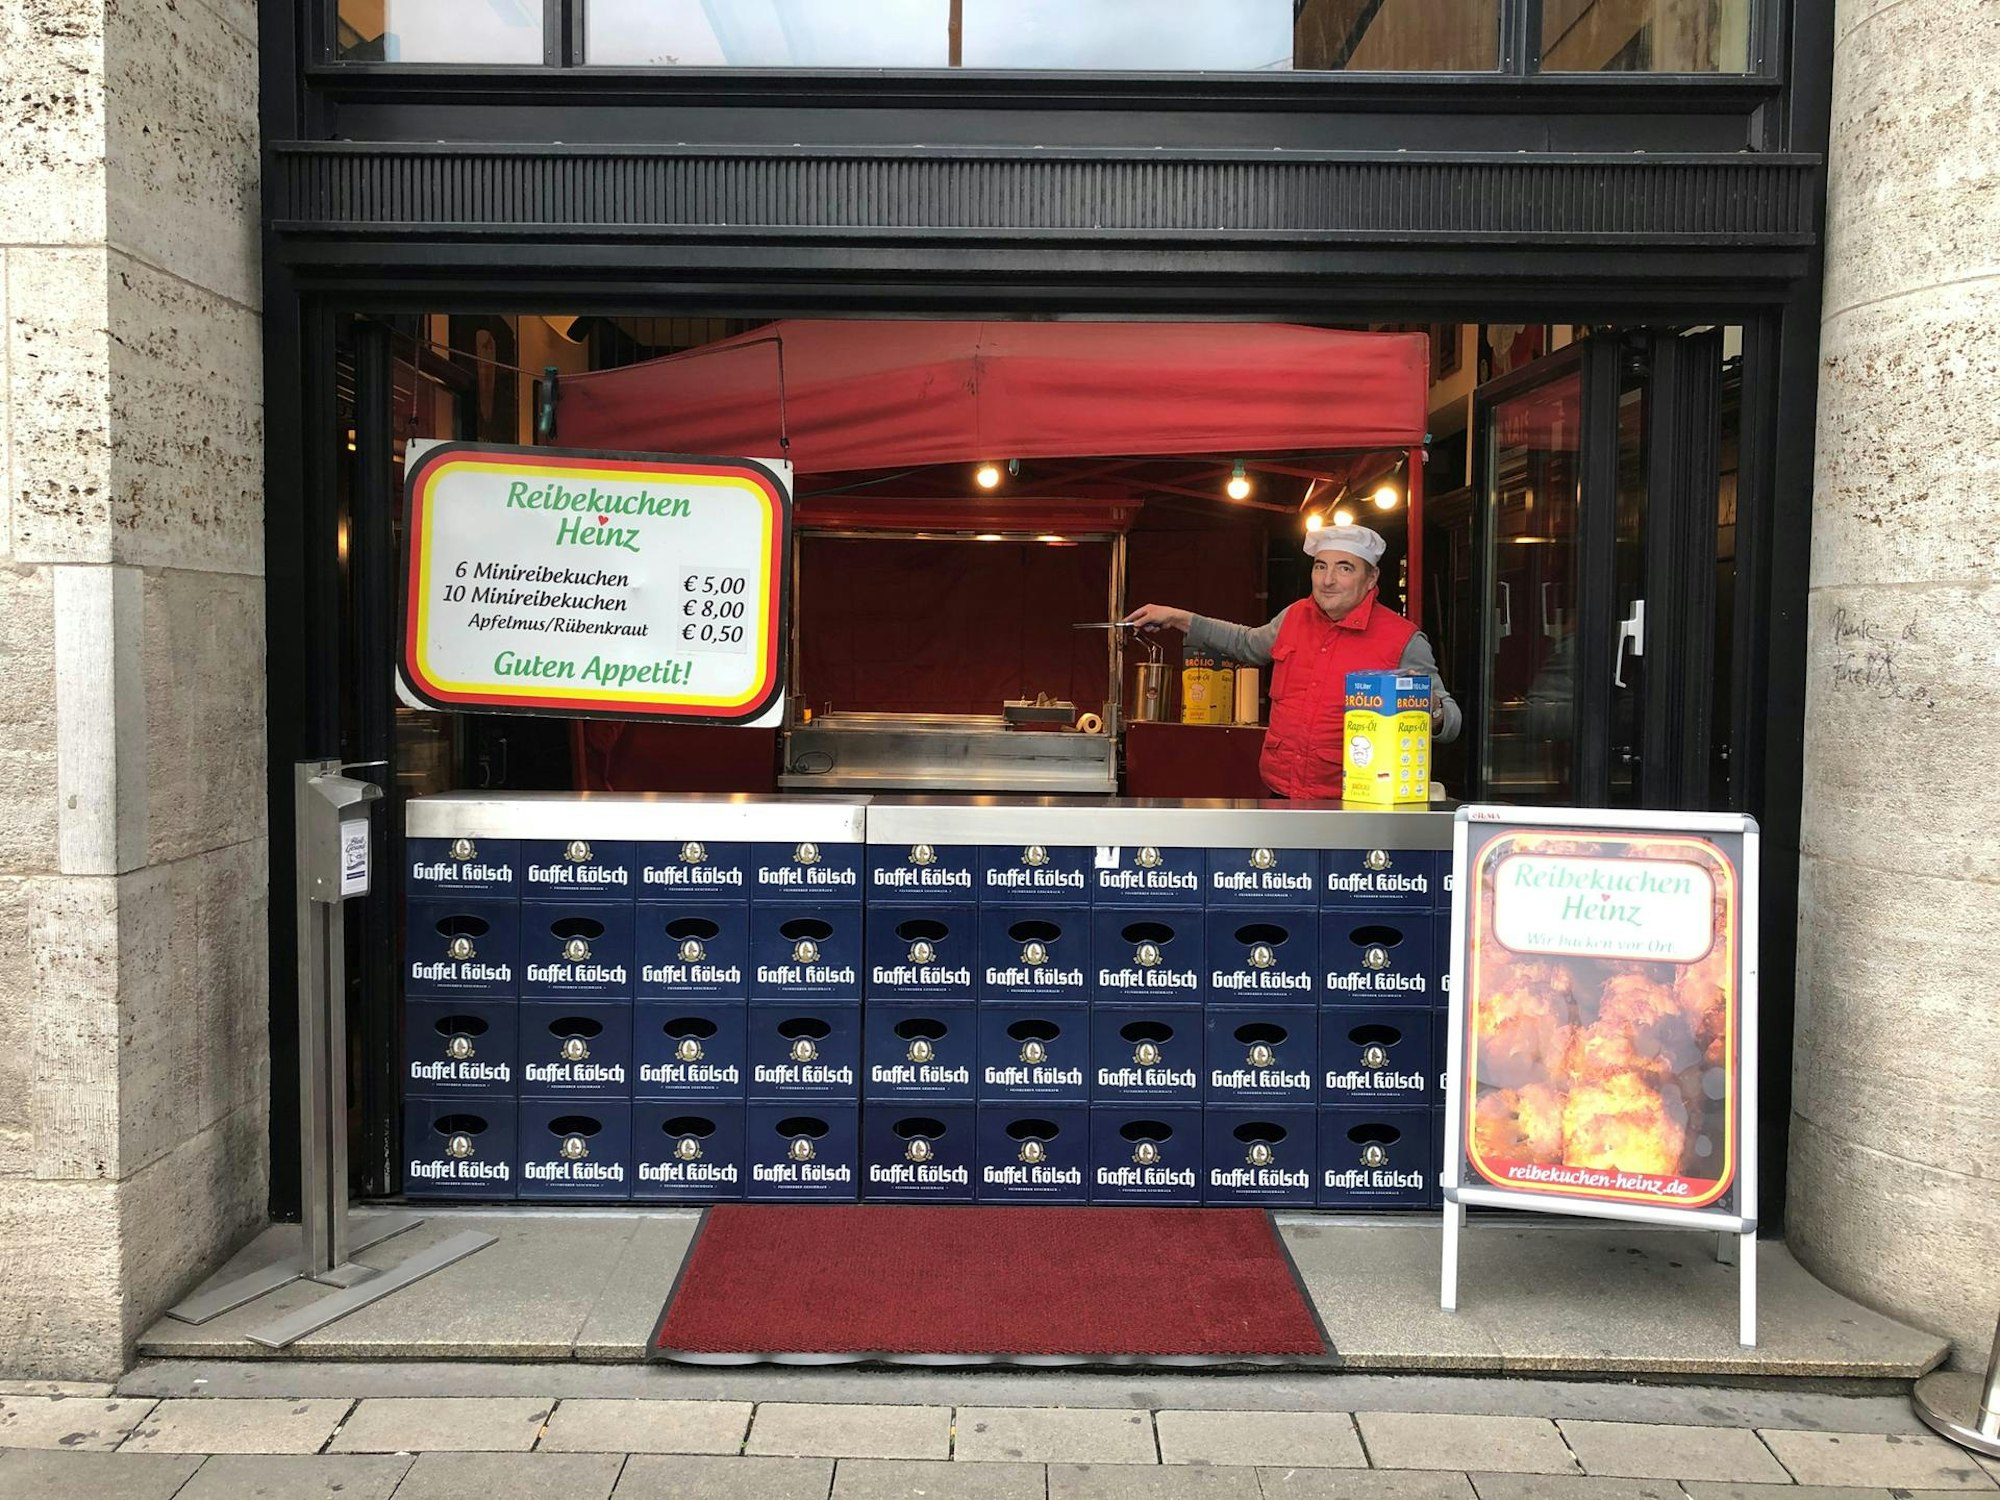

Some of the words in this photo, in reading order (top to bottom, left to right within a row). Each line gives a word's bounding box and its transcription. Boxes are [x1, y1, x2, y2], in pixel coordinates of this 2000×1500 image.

[507, 481, 691, 517] Reibekuchen
[556, 516, 640, 552] Heinz
[454, 561, 468, 578] 6
[473, 562, 629, 588] Minireibekuchen
[683, 575, 698, 593] €
[702, 576, 745, 596] 5,00
[442, 585, 466, 603] 10
[471, 586, 628, 612] Minireibekuchen
[682, 599, 697, 616] €
[701, 600, 745, 620] 8,00
[467, 613, 649, 637] Apfelmus/Rübenkraut
[682, 623, 697, 641] €
[700, 624, 744, 644] 0,50
[494, 651, 575, 679] Guten
[580, 655, 694, 687] Appetit!
[414, 862, 458, 881] Gaffel
[463, 863, 512, 883] Kölsch
[529, 863, 574, 882] Gaffel
[577, 864, 627, 884] Kölsch
[644, 864, 689, 883] Gaffel
[692, 865, 742, 885] Kölsch
[759, 865, 803, 884] Gaffel
[807, 866, 856, 886] Kölsch
[874, 867, 919, 886] Gaffel
[921, 868, 971, 888] Kölsch
[987, 868, 1032, 887] Gaffel
[1034, 869, 1084, 889] Kölsch
[1100, 869, 1145, 888] Gaffel
[1147, 870, 1197, 890] Kölsch
[1214, 870, 1258, 889] Gaffel
[1262, 871, 1312, 891] Kölsch
[1329, 871, 1374, 890] Gaffel
[1377, 872, 1427, 892] Kölsch
[1514, 862, 1691, 894] Reibekuchen
[1561, 894, 1643, 927] Heinz
[413, 961, 457, 980] Gaffel
[461, 962, 511, 982] Kölsch
[527, 962, 573, 981] Gaffel
[575, 963, 626, 983] Kölsch
[643, 963, 687, 982] Gaffel
[691, 964, 740, 984] Kölsch
[758, 964, 802, 983] Gaffel
[806, 965, 854, 985] Kölsch
[873, 966, 919, 985] Gaffel
[920, 967, 970, 987] Kölsch
[986, 967, 1030, 986] Gaffel
[1034, 968, 1083, 988] Kölsch
[1100, 968, 1144, 987] Gaffel
[1147, 969, 1197, 989] Kölsch
[1213, 969, 1258, 988] Gaffel
[1260, 970, 1311, 990] Kölsch
[1327, 970, 1372, 989] Gaffel
[1375, 971, 1425, 991] Kölsch
[411, 1060, 457, 1079] Gaffel
[459, 1061, 510, 1081] Kölsch
[526, 1061, 571, 1080] Gaffel
[574, 1062, 624, 1082] Kölsch
[640, 1062, 686, 1081] Gaffel
[688, 1063, 738, 1083] Kölsch
[755, 1063, 800, 1082] Gaffel
[802, 1064, 852, 1084] Kölsch
[872, 1065, 918, 1084] Gaffel
[919, 1066, 969, 1086] Kölsch
[985, 1066, 1029, 1085] Gaffel
[1033, 1067, 1082, 1087] Kölsch
[1099, 1067, 1143, 1086] Gaffel
[1146, 1068, 1196, 1088] Kölsch
[1212, 1068, 1257, 1087] Gaffel
[1260, 1069, 1310, 1089] Kölsch
[1326, 1069, 1371, 1088] Gaffel
[1374, 1070, 1424, 1090] Kölsch
[411, 1159, 456, 1178] Gaffel
[458, 1160, 509, 1180] Kölsch
[525, 1160, 571, 1179] Gaffel
[573, 1161, 623, 1181] Kölsch
[639, 1161, 685, 1180] Gaffel
[687, 1162, 737, 1182] Kölsch
[753, 1162, 798, 1181] Gaffel
[802, 1163, 850, 1183] Kölsch
[870, 1164, 915, 1183] Gaffel
[918, 1165, 968, 1185] Kölsch
[984, 1165, 1028, 1184] Gaffel
[1032, 1166, 1081, 1186] Kölsch
[1097, 1166, 1142, 1185] Gaffel
[1145, 1167, 1195, 1187] Kölsch
[1211, 1167, 1256, 1186] Gaffel
[1259, 1168, 1309, 1188] Kölsch
[1325, 1168, 1370, 1187] Gaffel
[1373, 1169, 1423, 1189] Kölsch
[1508, 1164, 1689, 1195] reibekuchen-heinz.de
